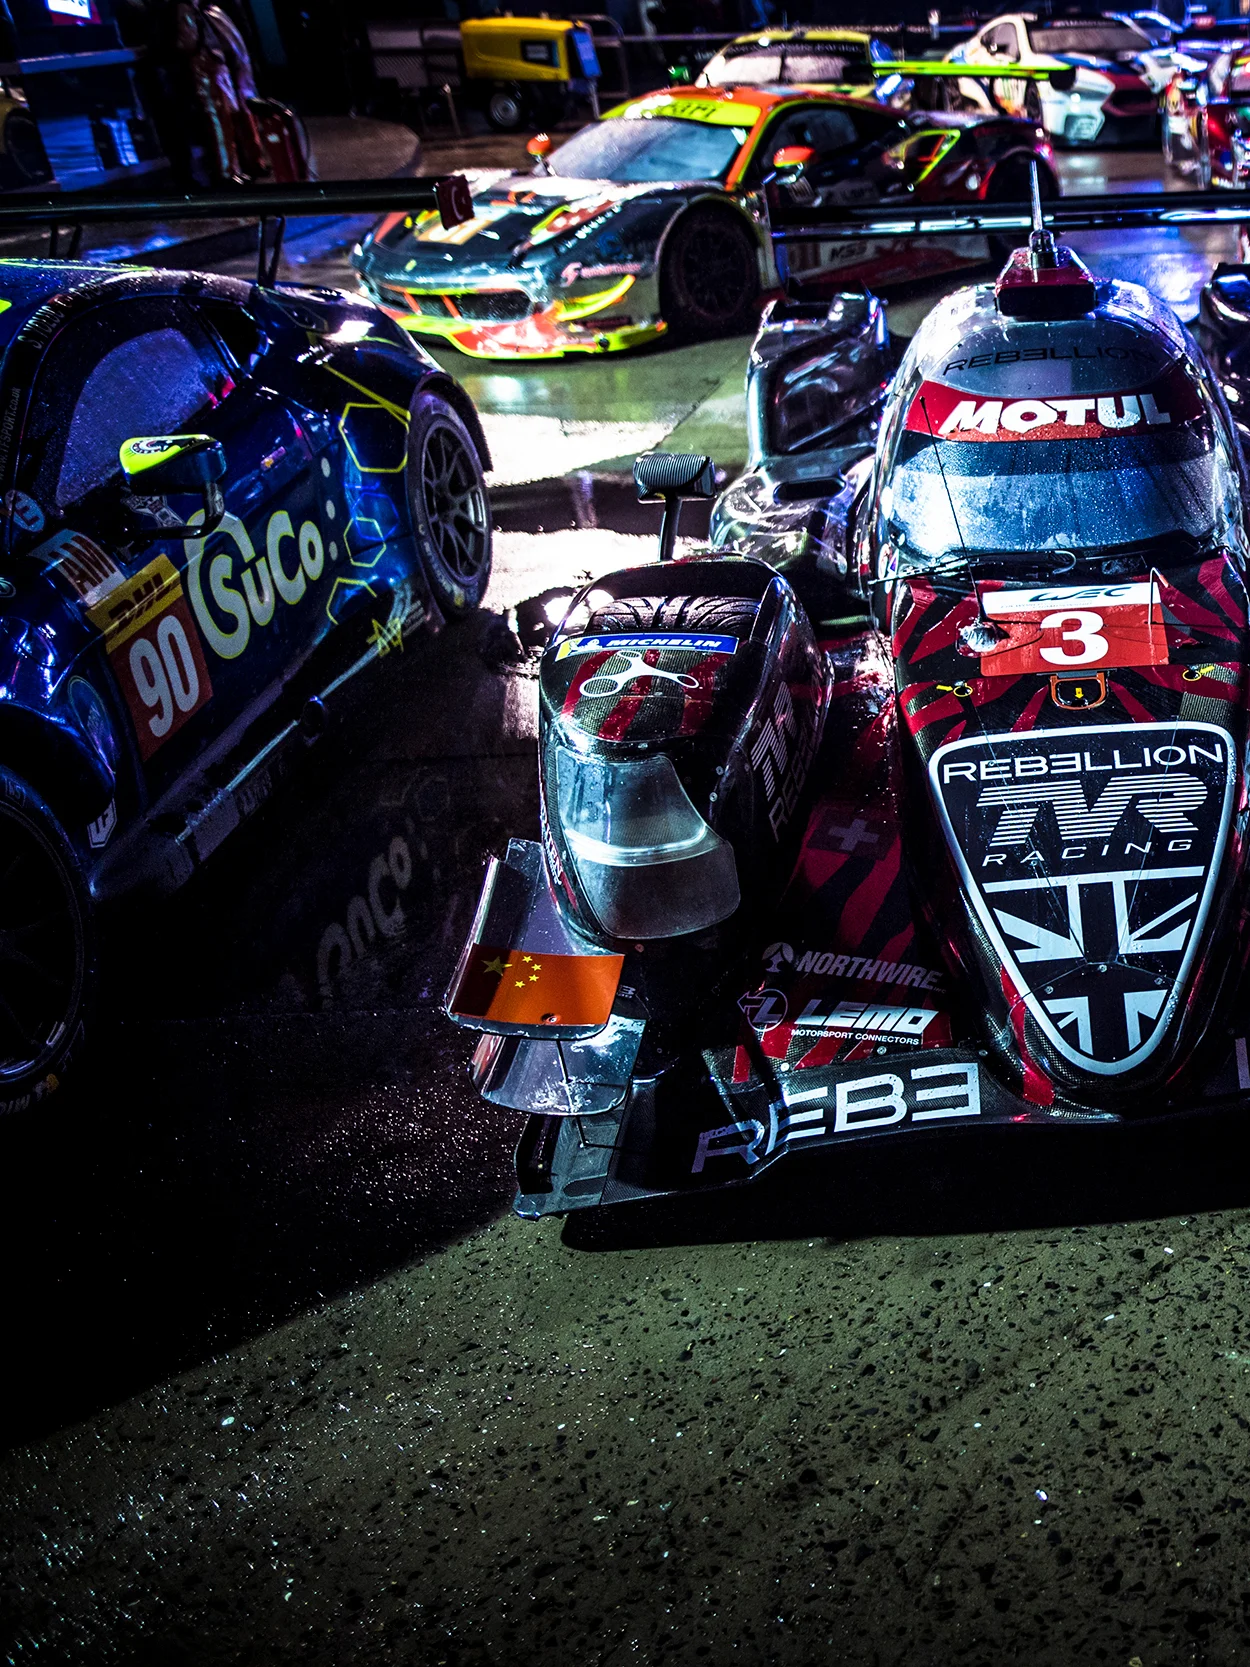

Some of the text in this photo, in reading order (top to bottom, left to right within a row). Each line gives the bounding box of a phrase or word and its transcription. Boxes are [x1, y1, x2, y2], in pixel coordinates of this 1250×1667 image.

[937, 394, 1172, 434] MOTUL
[1029, 586, 1131, 603] WEC
[606, 638, 723, 648] MICHELIN
[1039, 610, 1109, 666] 3
[129, 614, 200, 738] 90
[943, 743, 1224, 784] REBELLION
[976, 773, 1208, 847] TVR
[982, 839, 1193, 867] RACING
[796, 950, 943, 989] NORTHWIRE
[794, 999, 939, 1035] LEMO
[791, 1028, 920, 1046] MOTORSPORT CONNECTORS
